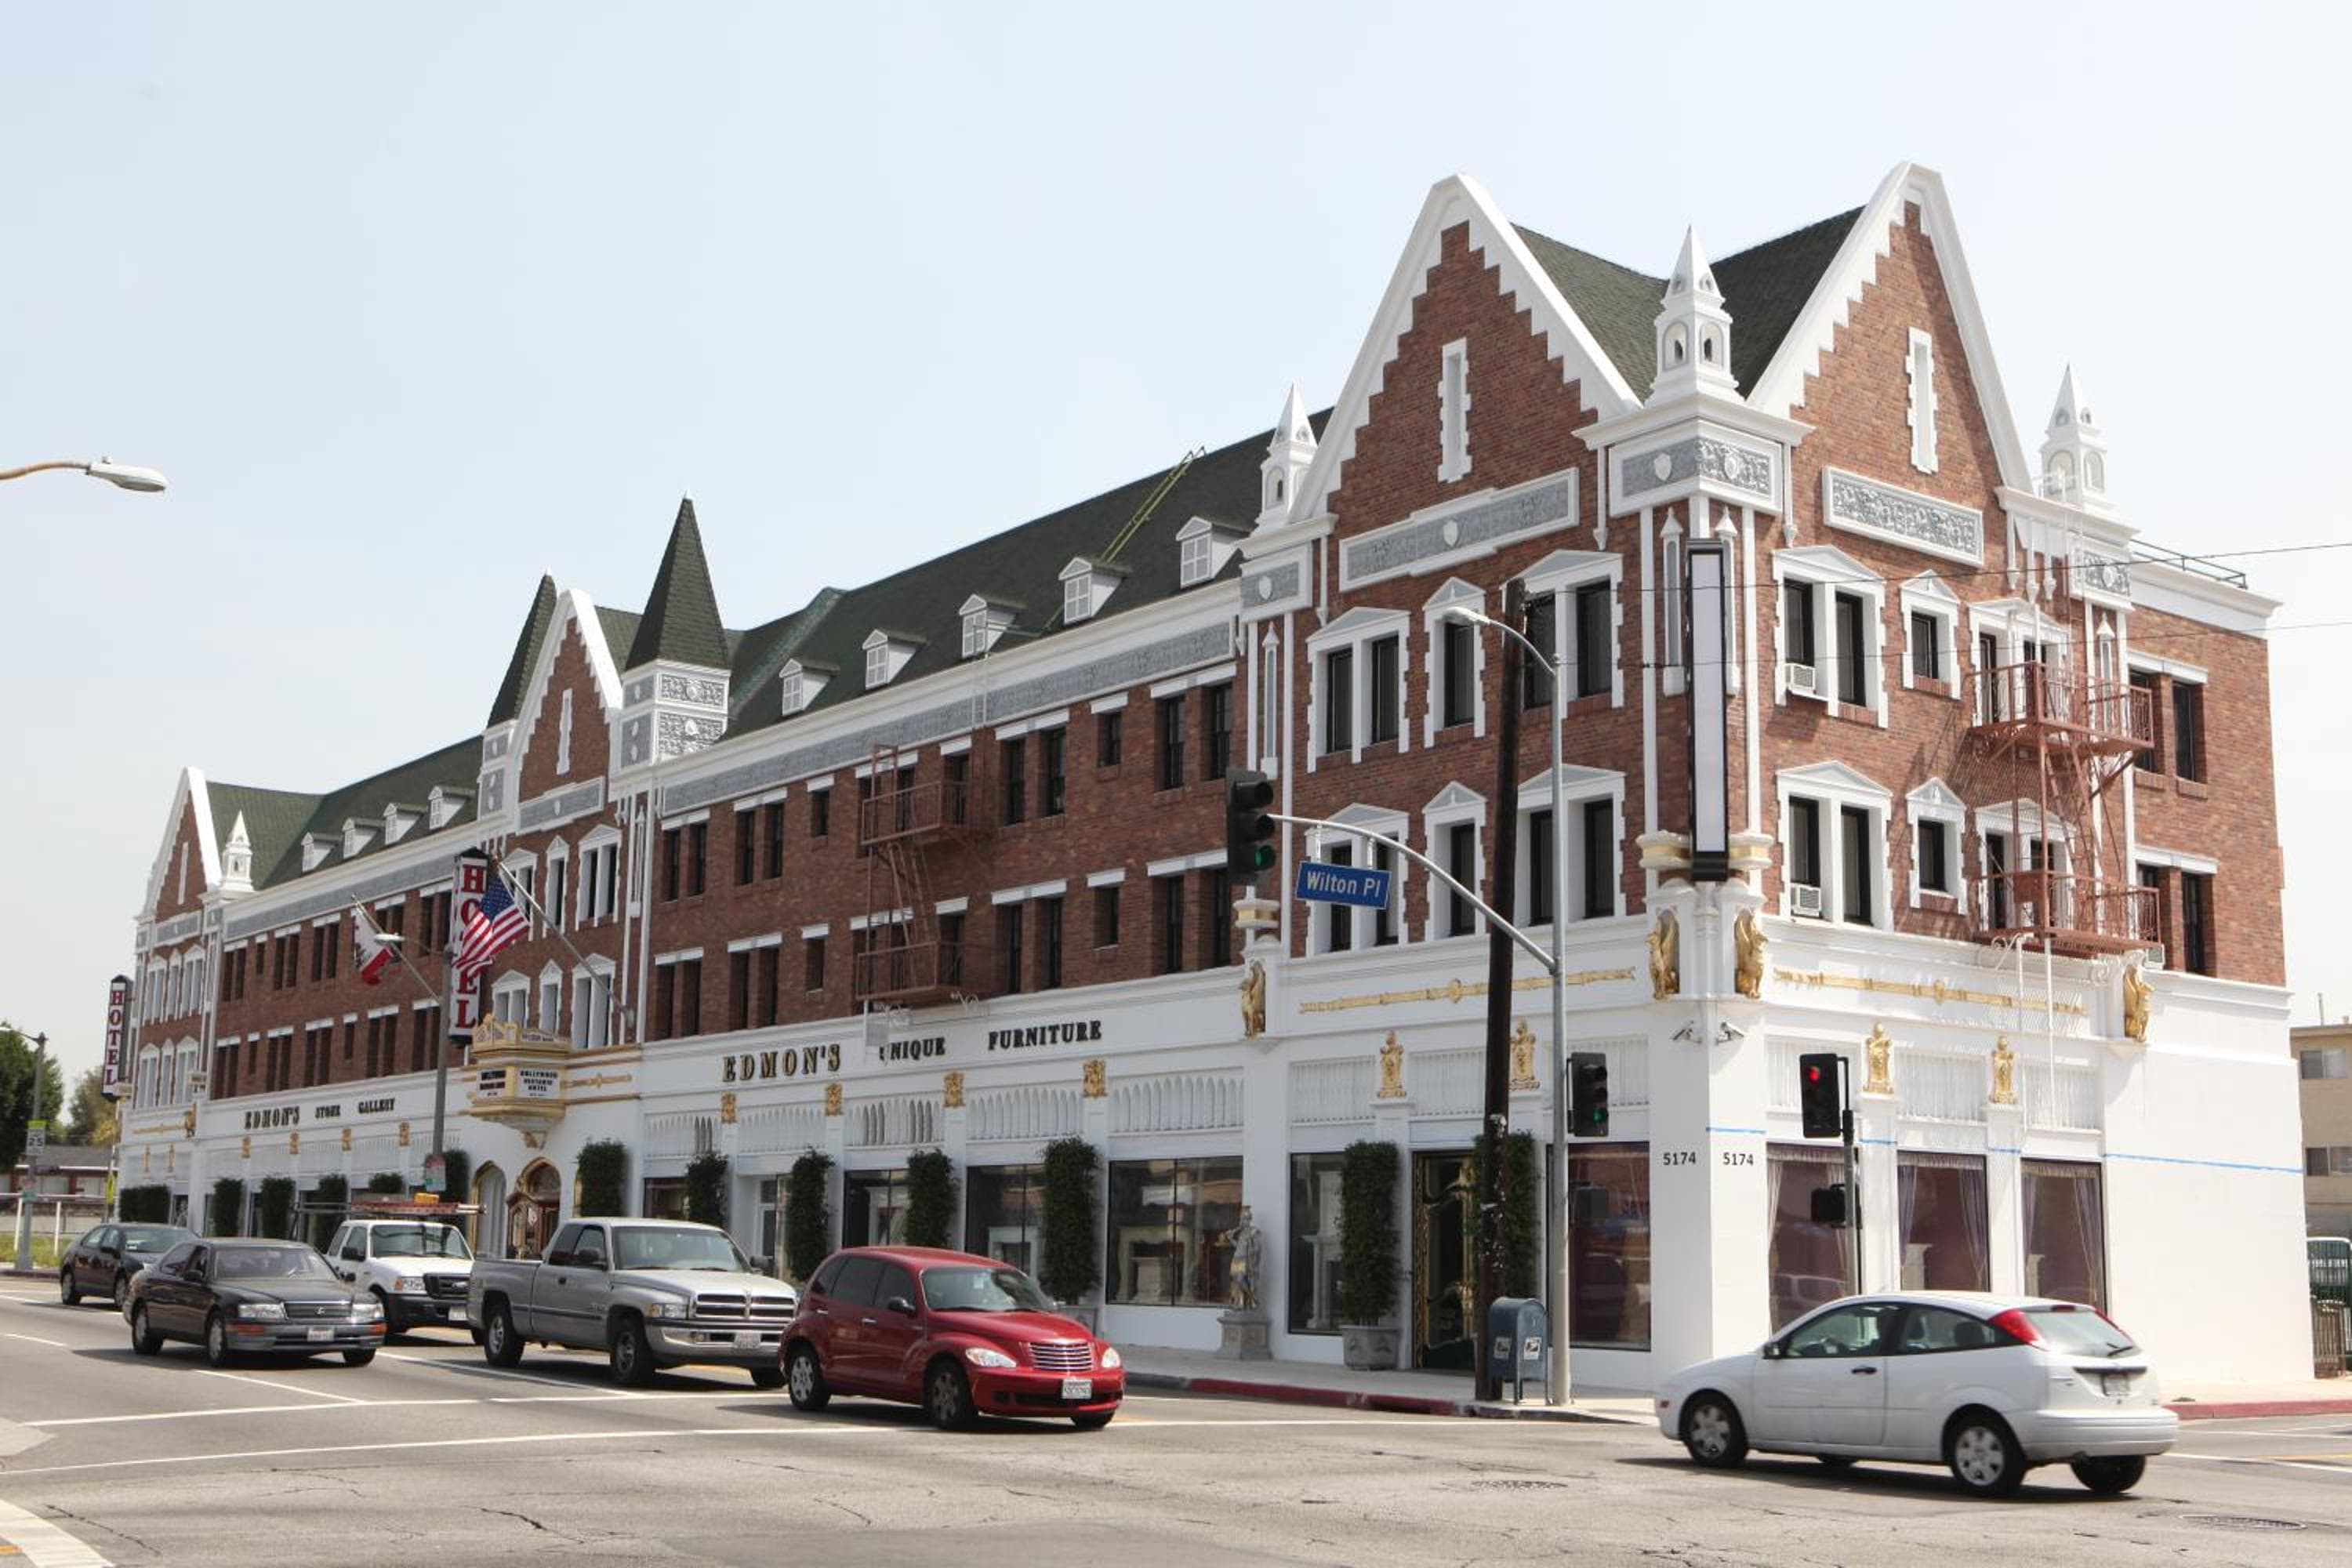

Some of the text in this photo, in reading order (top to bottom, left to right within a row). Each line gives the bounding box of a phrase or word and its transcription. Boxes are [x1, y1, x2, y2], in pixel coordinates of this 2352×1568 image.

[1307, 871, 1381, 898] Wilton Pl
[105, 990, 124, 1086] HOTEL
[722, 1044, 841, 1082] EDMON'S
[988, 1020, 1102, 1051] FURNITURE
[244, 1105, 299, 1130] EDMON'S
[358, 1098, 395, 1114] GALLERY
[1663, 1151, 1697, 1166] 5174
[1722, 1151, 1754, 1166] 5174
